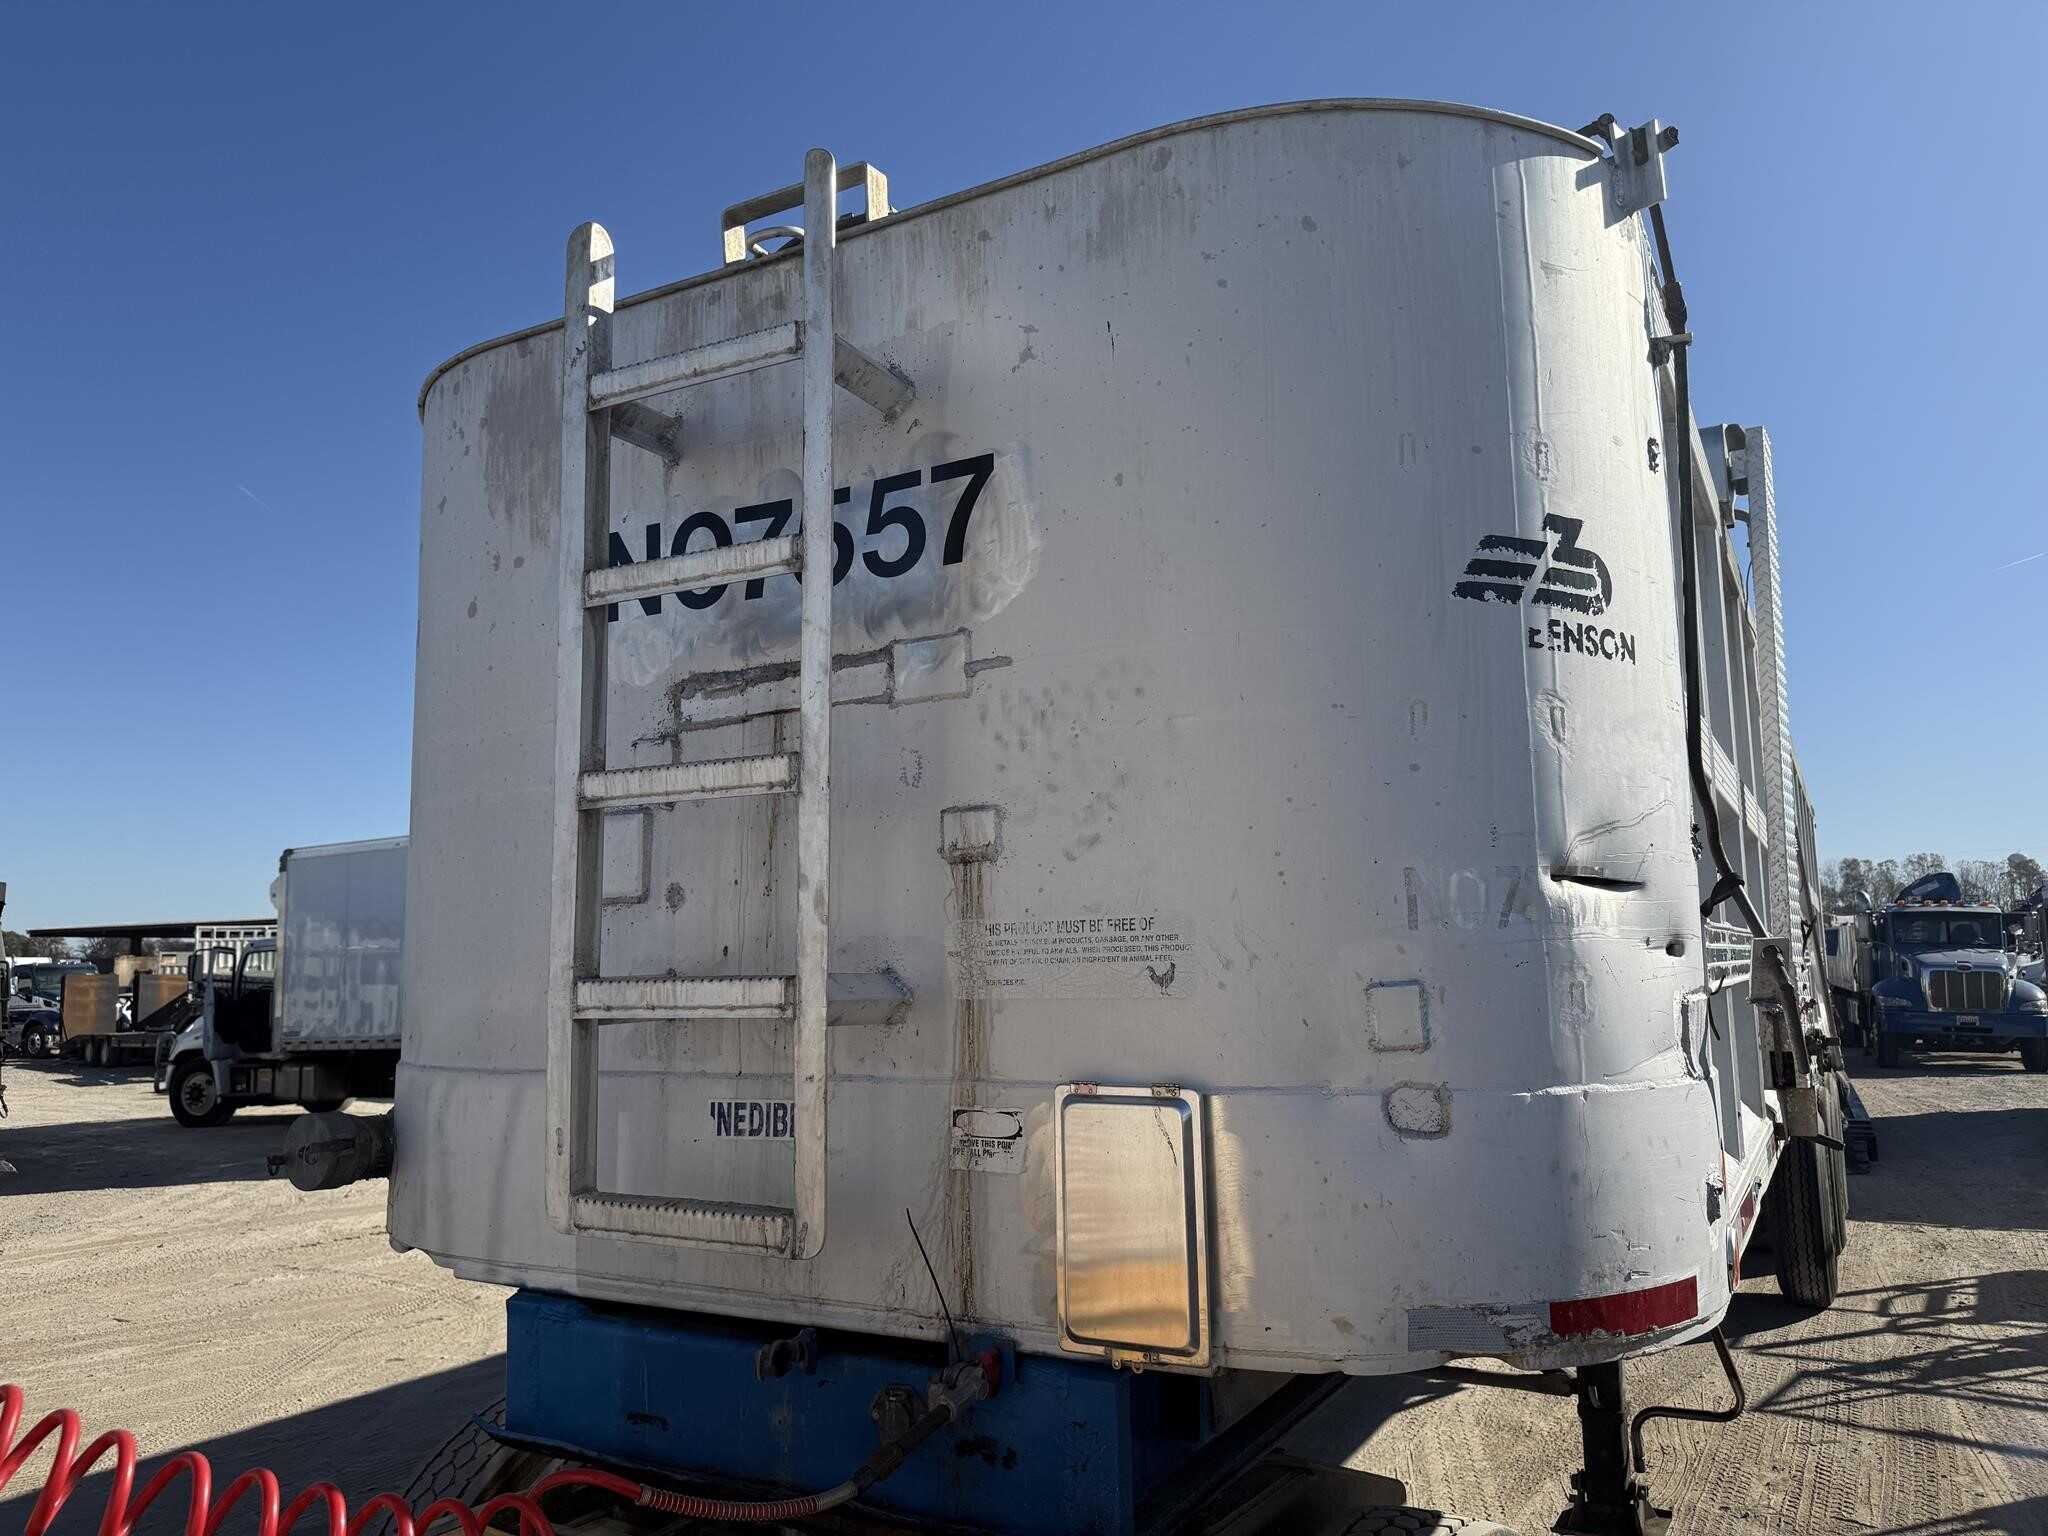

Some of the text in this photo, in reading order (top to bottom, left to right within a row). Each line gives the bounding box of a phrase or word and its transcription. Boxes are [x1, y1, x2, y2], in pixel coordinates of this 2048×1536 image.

[1056, 919, 1086, 935] MUST
[1089, 918, 1103, 933] BE
[1107, 917, 1136, 932] FREE
[1140, 917, 1155, 931] OF
[1156, 934, 1179, 942] OTHER
[981, 1140, 995, 1149] THIS
